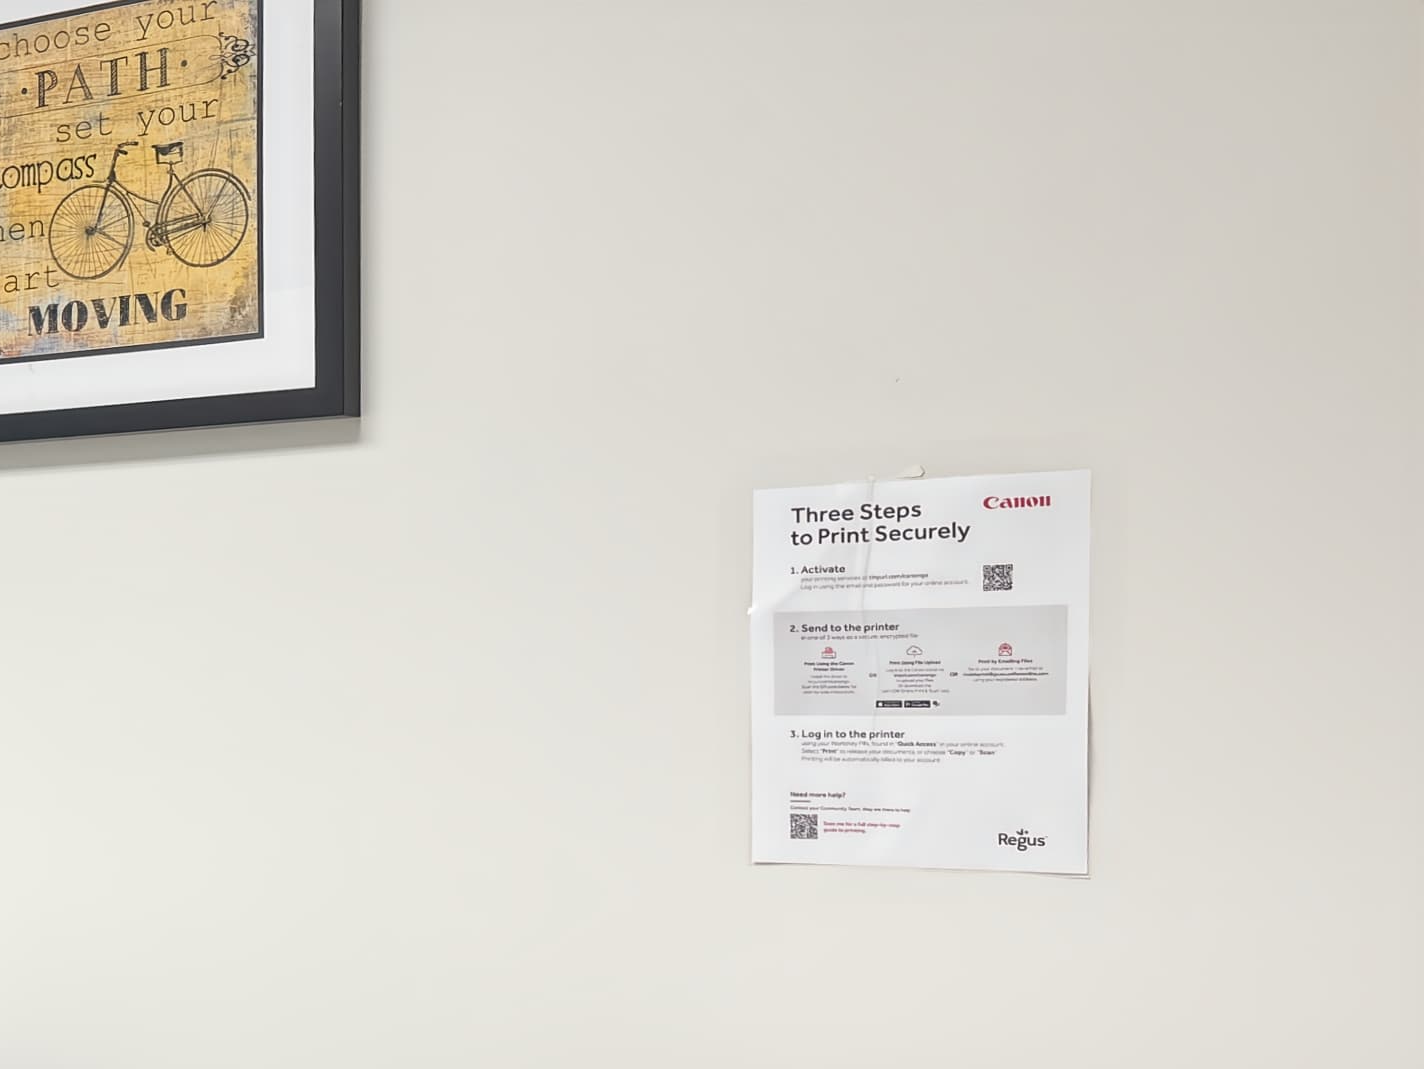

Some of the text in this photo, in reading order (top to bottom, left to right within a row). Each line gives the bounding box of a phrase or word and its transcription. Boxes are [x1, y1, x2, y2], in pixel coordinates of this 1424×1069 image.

[135, 0, 218, 41] your
[34, 47, 171, 109] PATH
[55, 97, 219, 144] set your
[27, 287, 188, 337] MOVING
[983, 495, 1051, 510] Canon
[791, 503, 922, 523] Three Steps
[791, 521, 971, 546] to Print Securely
[801, 565, 846, 575] Activate
[801, 624, 828, 633] Send
[830, 624, 842, 632] to
[844, 623, 862, 632] the
[863, 622, 900, 634] printer
[801, 729, 822, 740] Log
[823, 730, 833, 738] in
[835, 730, 847, 738] to
[848, 729, 867, 738] the
[869, 729, 905, 740] printer
[998, 832, 1046, 851] Regus
